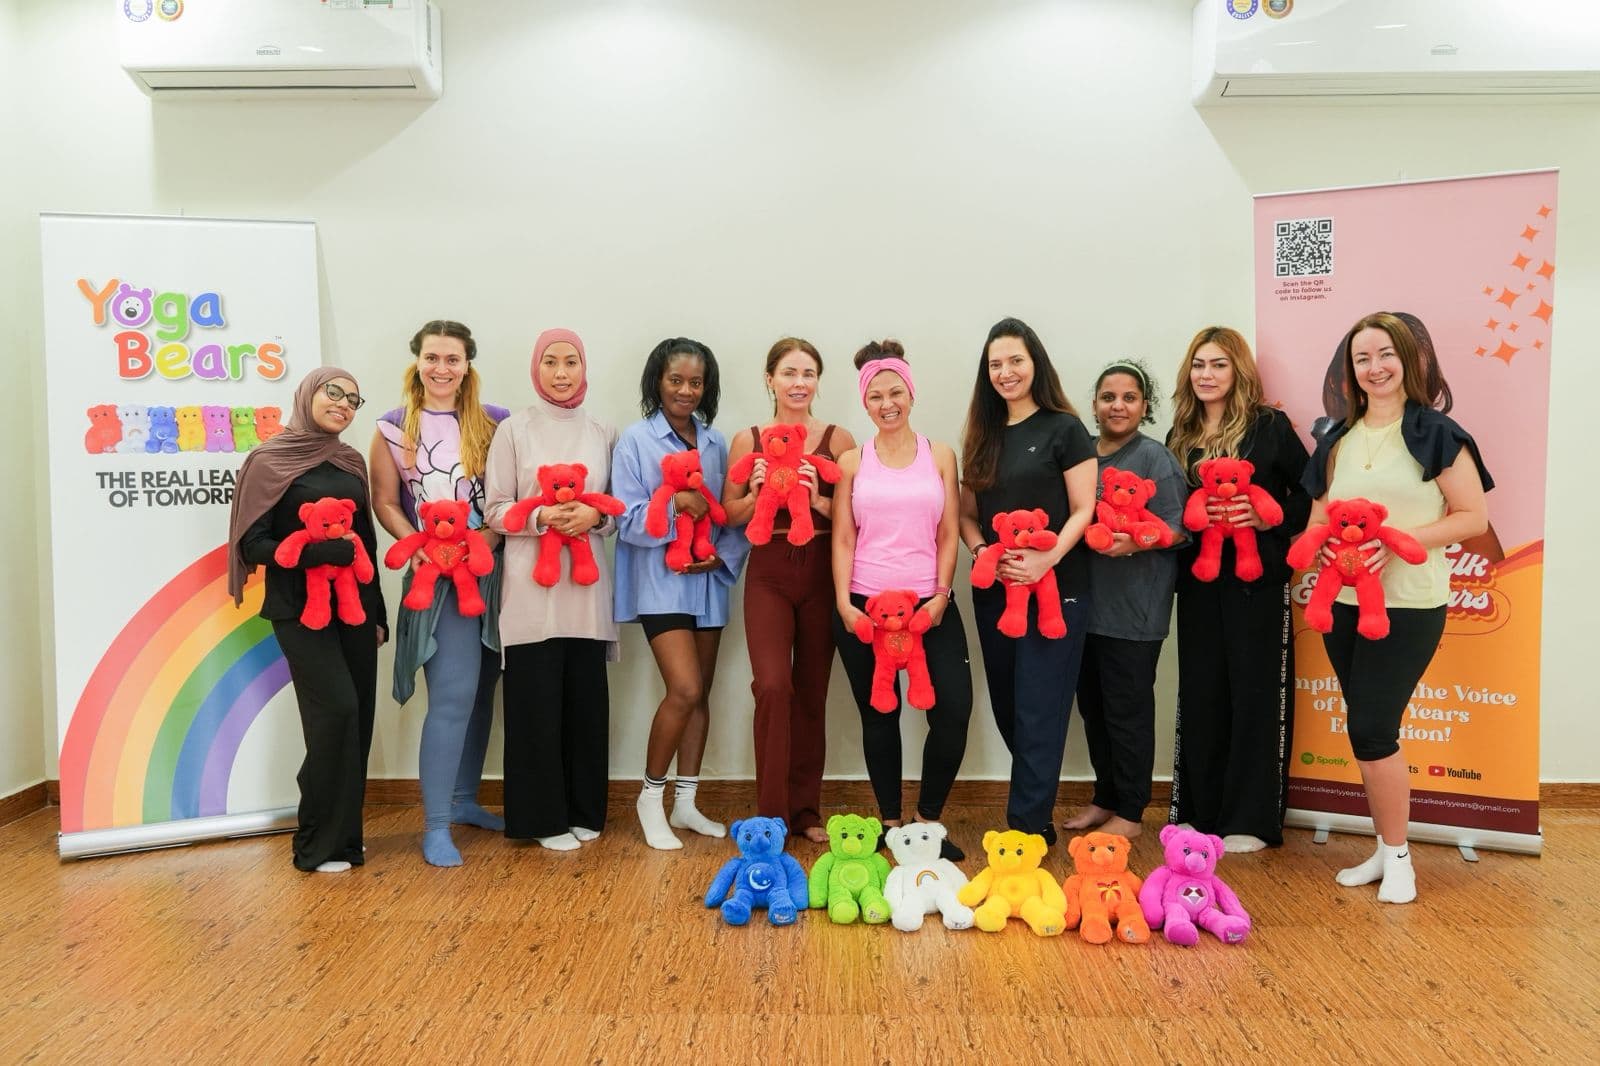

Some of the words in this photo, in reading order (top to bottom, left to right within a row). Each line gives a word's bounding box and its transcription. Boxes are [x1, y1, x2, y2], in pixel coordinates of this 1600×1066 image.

[76, 278, 225, 341] Yoga
[113, 331, 286, 380] Bears
[95, 471, 137, 489] THE
[141, 470, 194, 488] REAL
[109, 490, 139, 507] OF
[143, 487, 234, 507] TOMORR
[1454, 684, 1518, 706] Voice
[1313, 696, 1338, 712] of
[1407, 703, 1471, 723] Years
[1316, 755, 1350, 767] Spotify
[1447, 767, 1482, 781] YouTube
[1410, 797, 1521, 814] etstalkearlyyears@gmail.com
